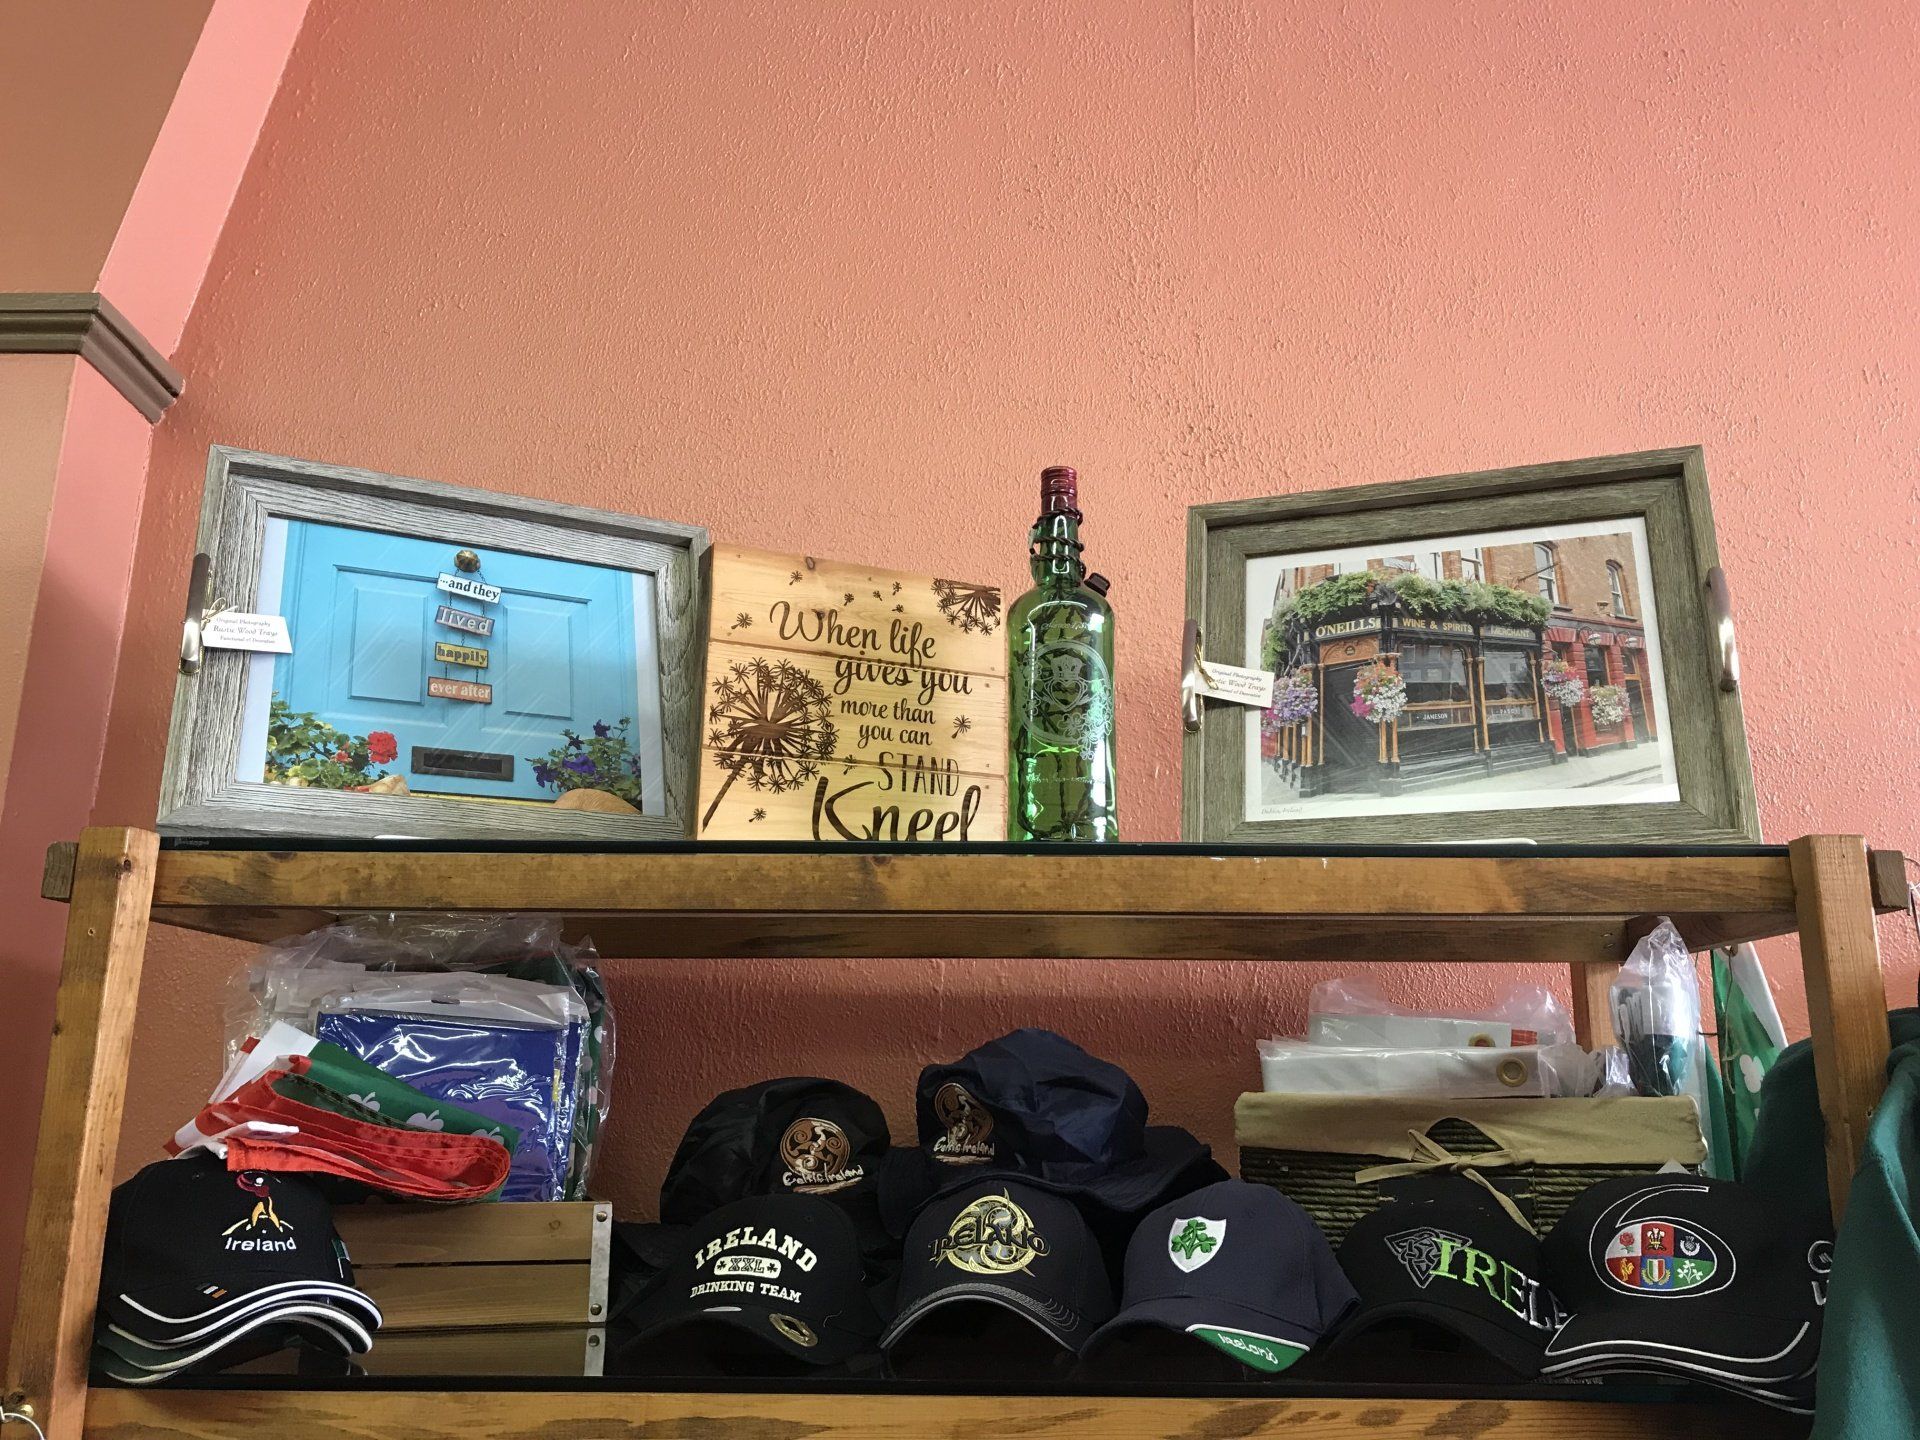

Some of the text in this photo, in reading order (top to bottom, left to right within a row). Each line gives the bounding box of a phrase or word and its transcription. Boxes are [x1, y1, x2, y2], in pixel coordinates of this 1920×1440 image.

[473, 584, 500, 601] they
[238, 626, 257, 635] Wood
[440, 608, 490, 632] lived
[1315, 616, 1376, 638] O'NEILLS
[1402, 617, 1530, 639] WINE & SPIRITS MERCHANT
[769, 600, 936, 672] When life
[436, 645, 488, 665] happily
[833, 651, 972, 706] gives you
[430, 681, 491, 699] ever after
[841, 698, 936, 725] more than
[1422, 712, 1448, 720] JAMESON
[857, 724, 933, 750] you can
[878, 751, 960, 797] STAND
[812, 776, 982, 841] Kneel
[961, 1134, 995, 1156] Ireland
[824, 1162, 864, 1183] Ireland
[224, 1236, 297, 1252] Ireland
[695, 1226, 818, 1272] IRELAND
[927, 1216, 1051, 1262] IRELAND
[728, 1257, 765, 1273] XXL
[689, 1280, 802, 1303] DRINKING TEAM
[1429, 1237, 1568, 1332] IRELA
